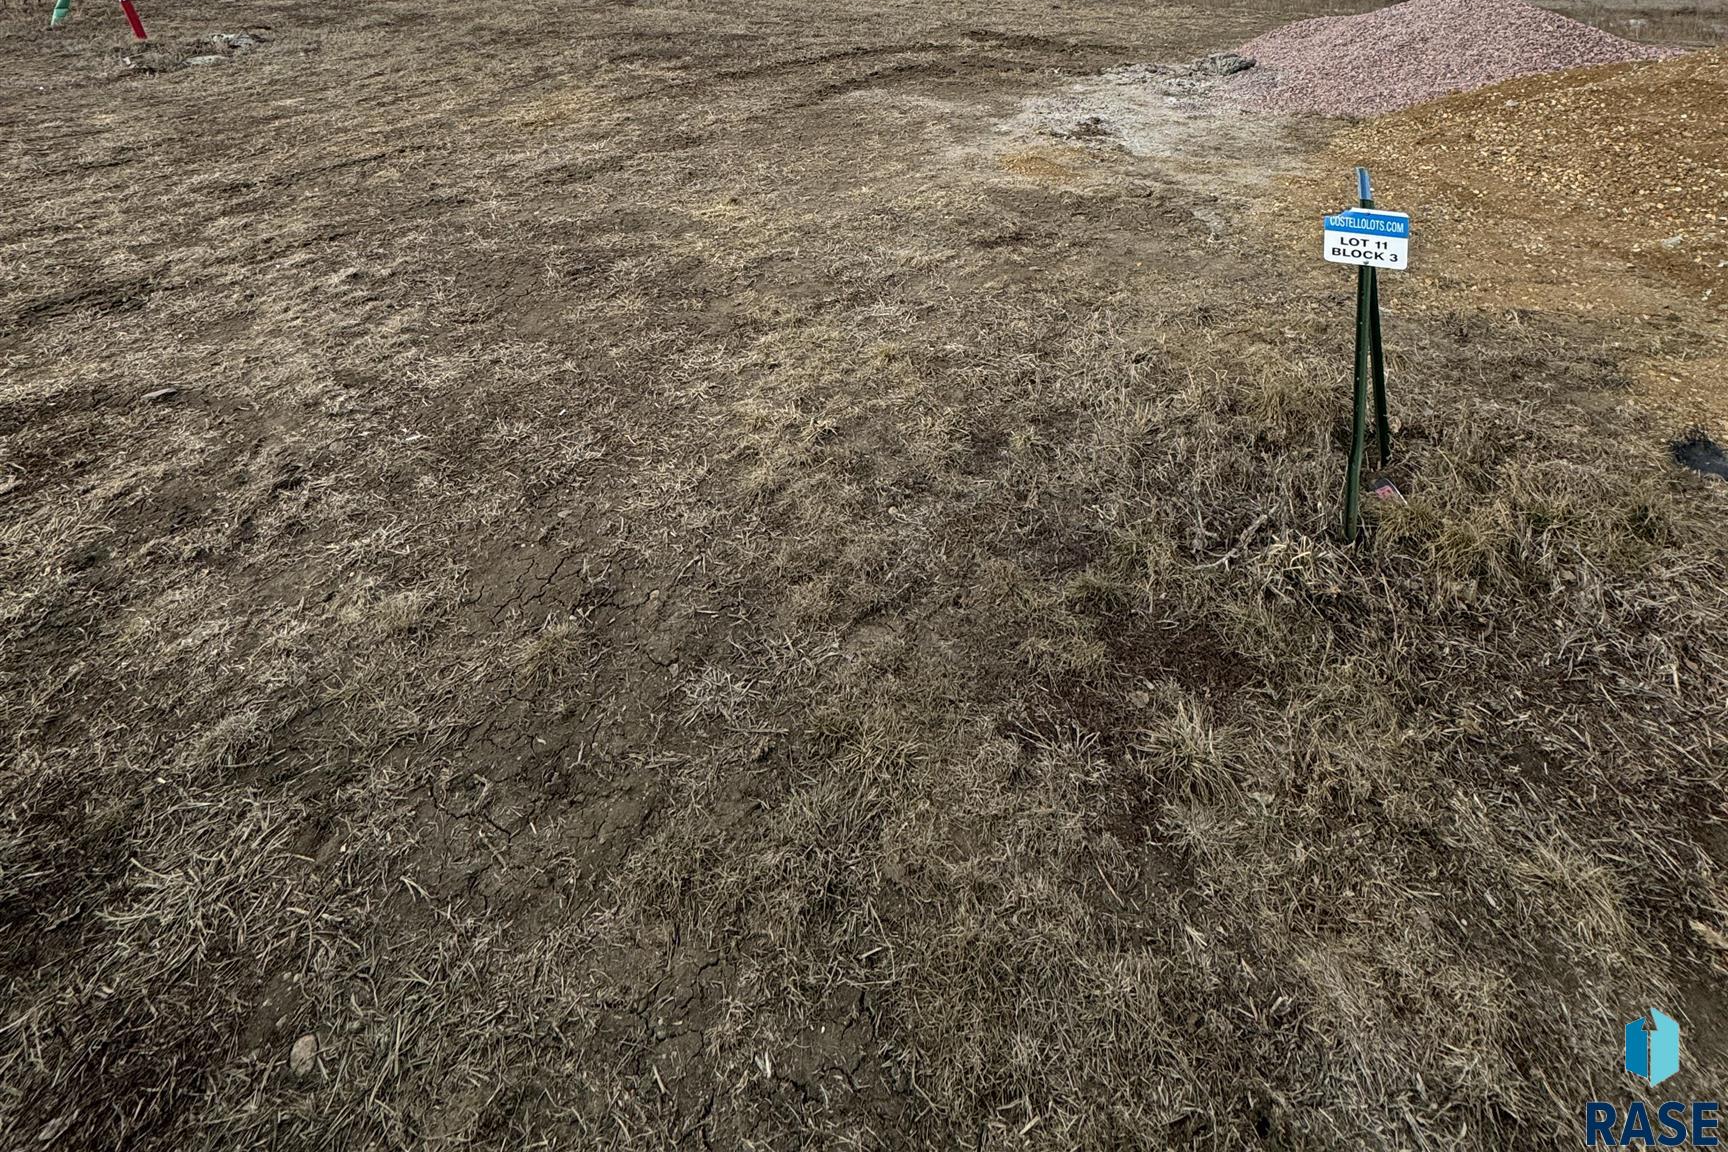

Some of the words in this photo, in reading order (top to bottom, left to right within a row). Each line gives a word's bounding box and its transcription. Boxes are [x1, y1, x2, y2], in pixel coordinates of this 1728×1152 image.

[1330, 215, 1404, 233] COSTELLOLOTS.COM
[1340, 236, 1370, 247] LOT
[1375, 241, 1388, 250] 11
[1331, 247, 1385, 261] BLOCK
[1389, 253, 1398, 262] 3
